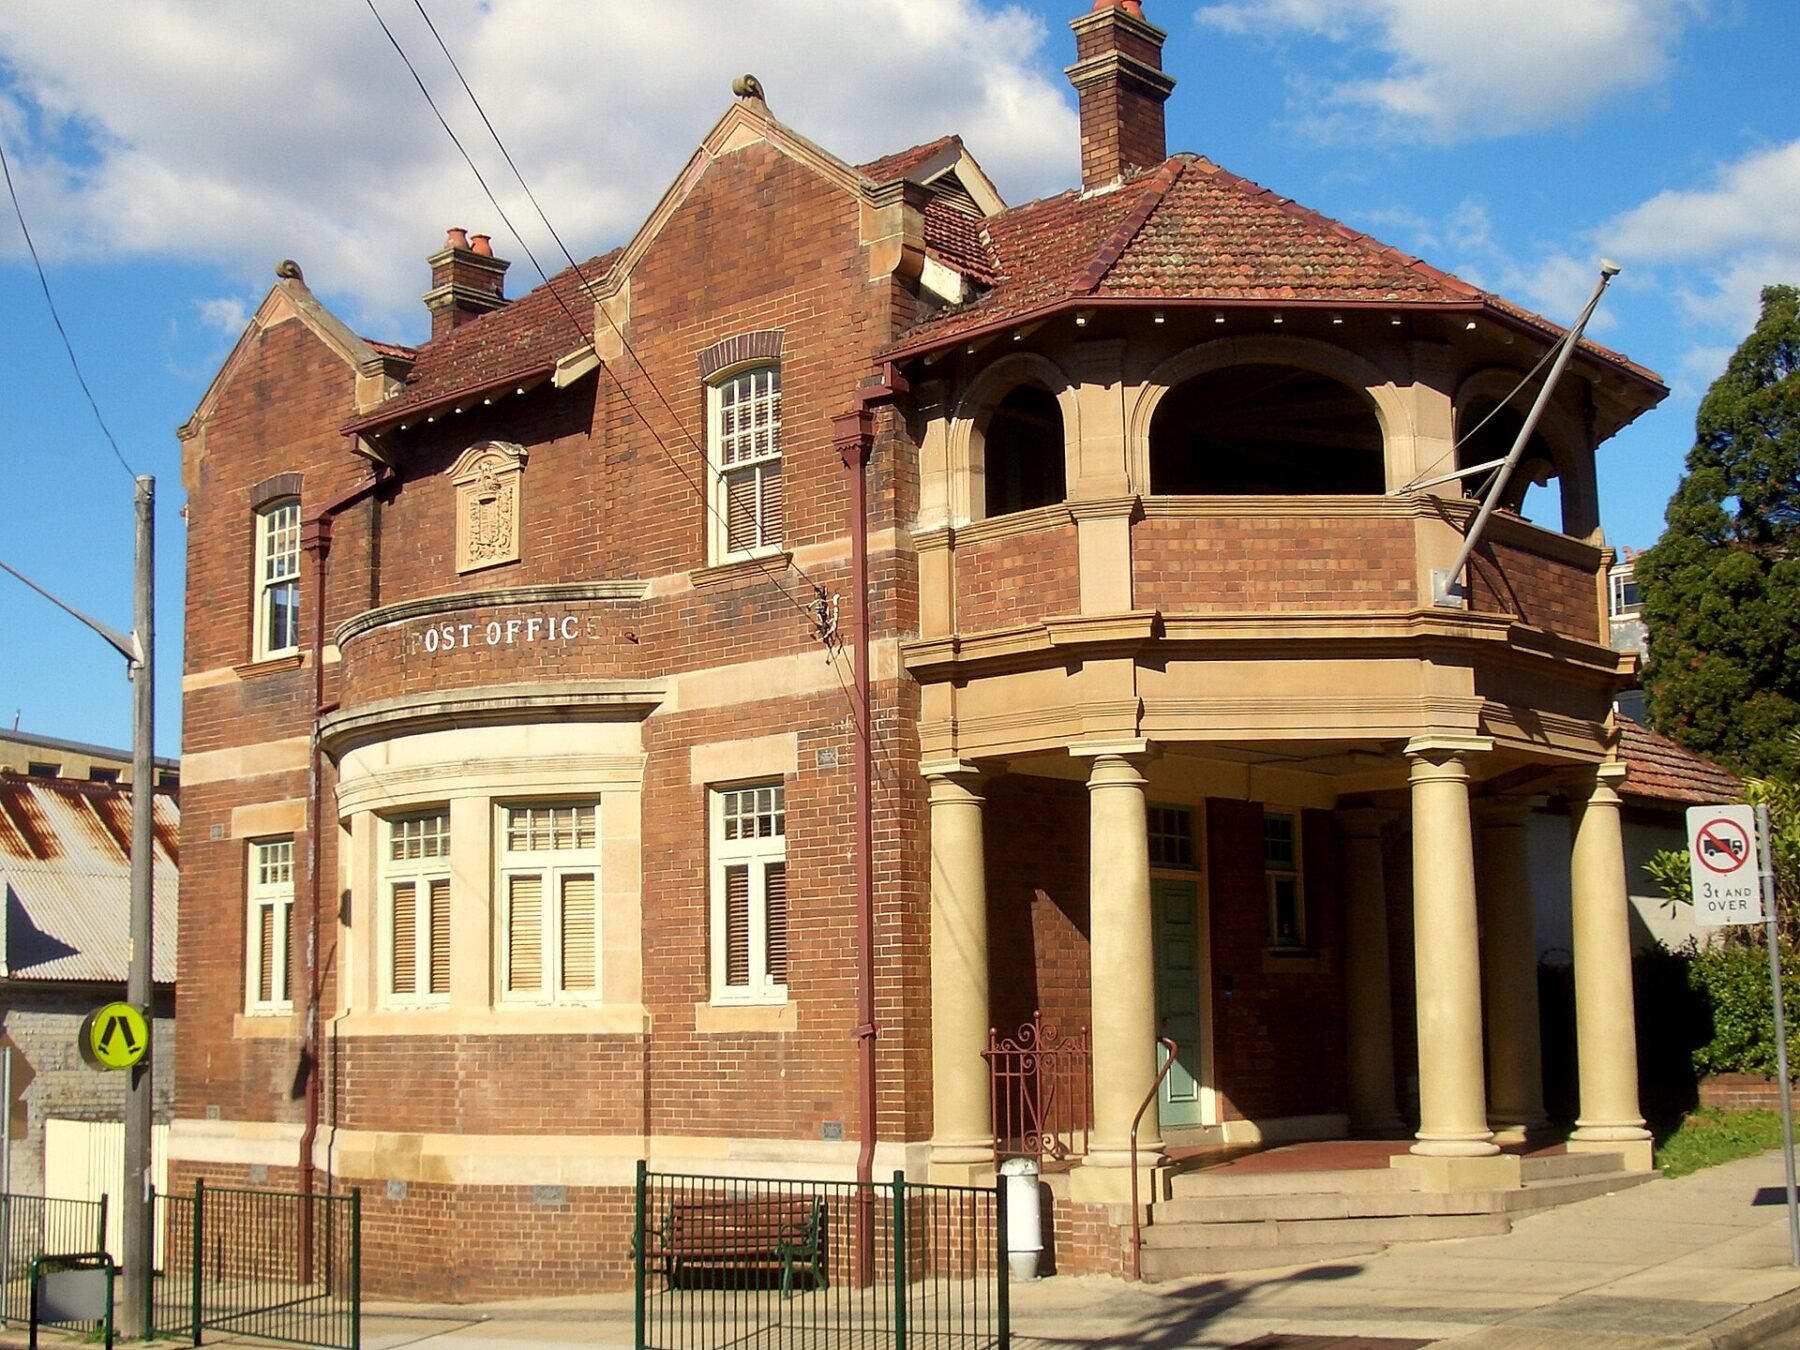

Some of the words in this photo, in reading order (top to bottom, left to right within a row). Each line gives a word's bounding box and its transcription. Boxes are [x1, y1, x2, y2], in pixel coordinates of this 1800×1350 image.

[1703, 882, 1719, 898] 3t
[1726, 888, 1751, 897] AND
[1708, 900, 1747, 911] OVER
